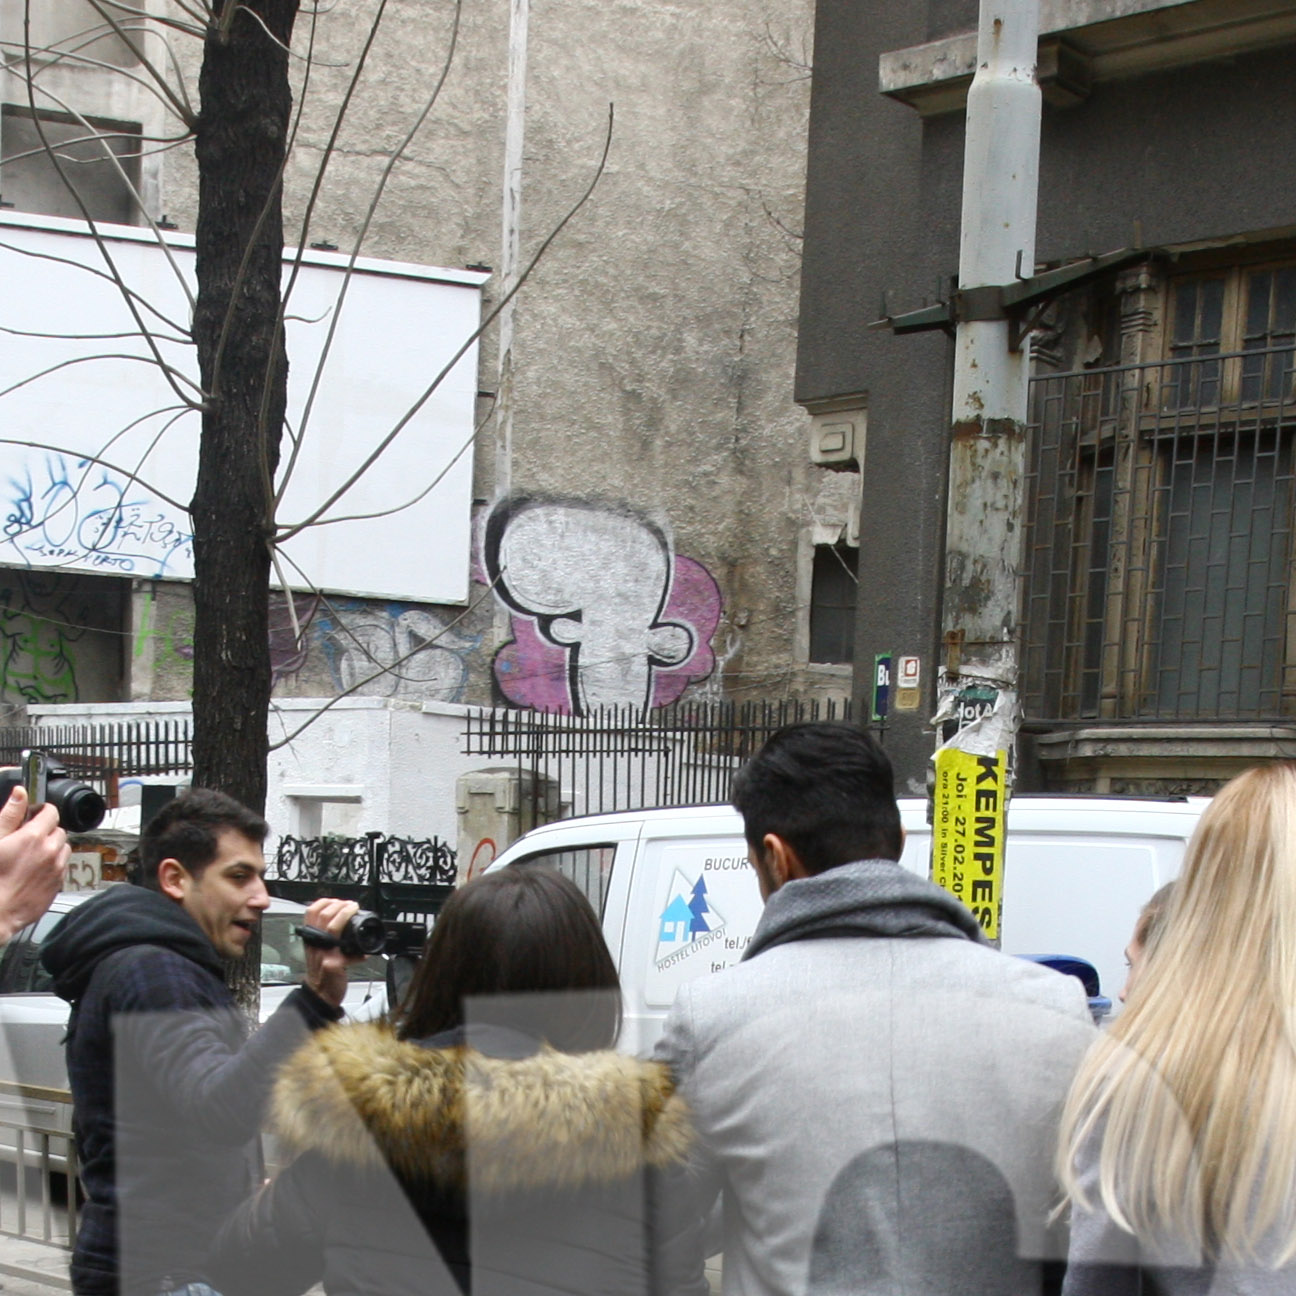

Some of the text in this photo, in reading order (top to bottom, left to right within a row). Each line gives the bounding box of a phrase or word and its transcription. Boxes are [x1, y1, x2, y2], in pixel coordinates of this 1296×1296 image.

[955, 772, 968, 799] Joi
[940, 793, 950, 824] 21:00
[971, 757, 999, 930] KEMPES
[657, 927, 727, 973] HOSTEL LITOVOI
